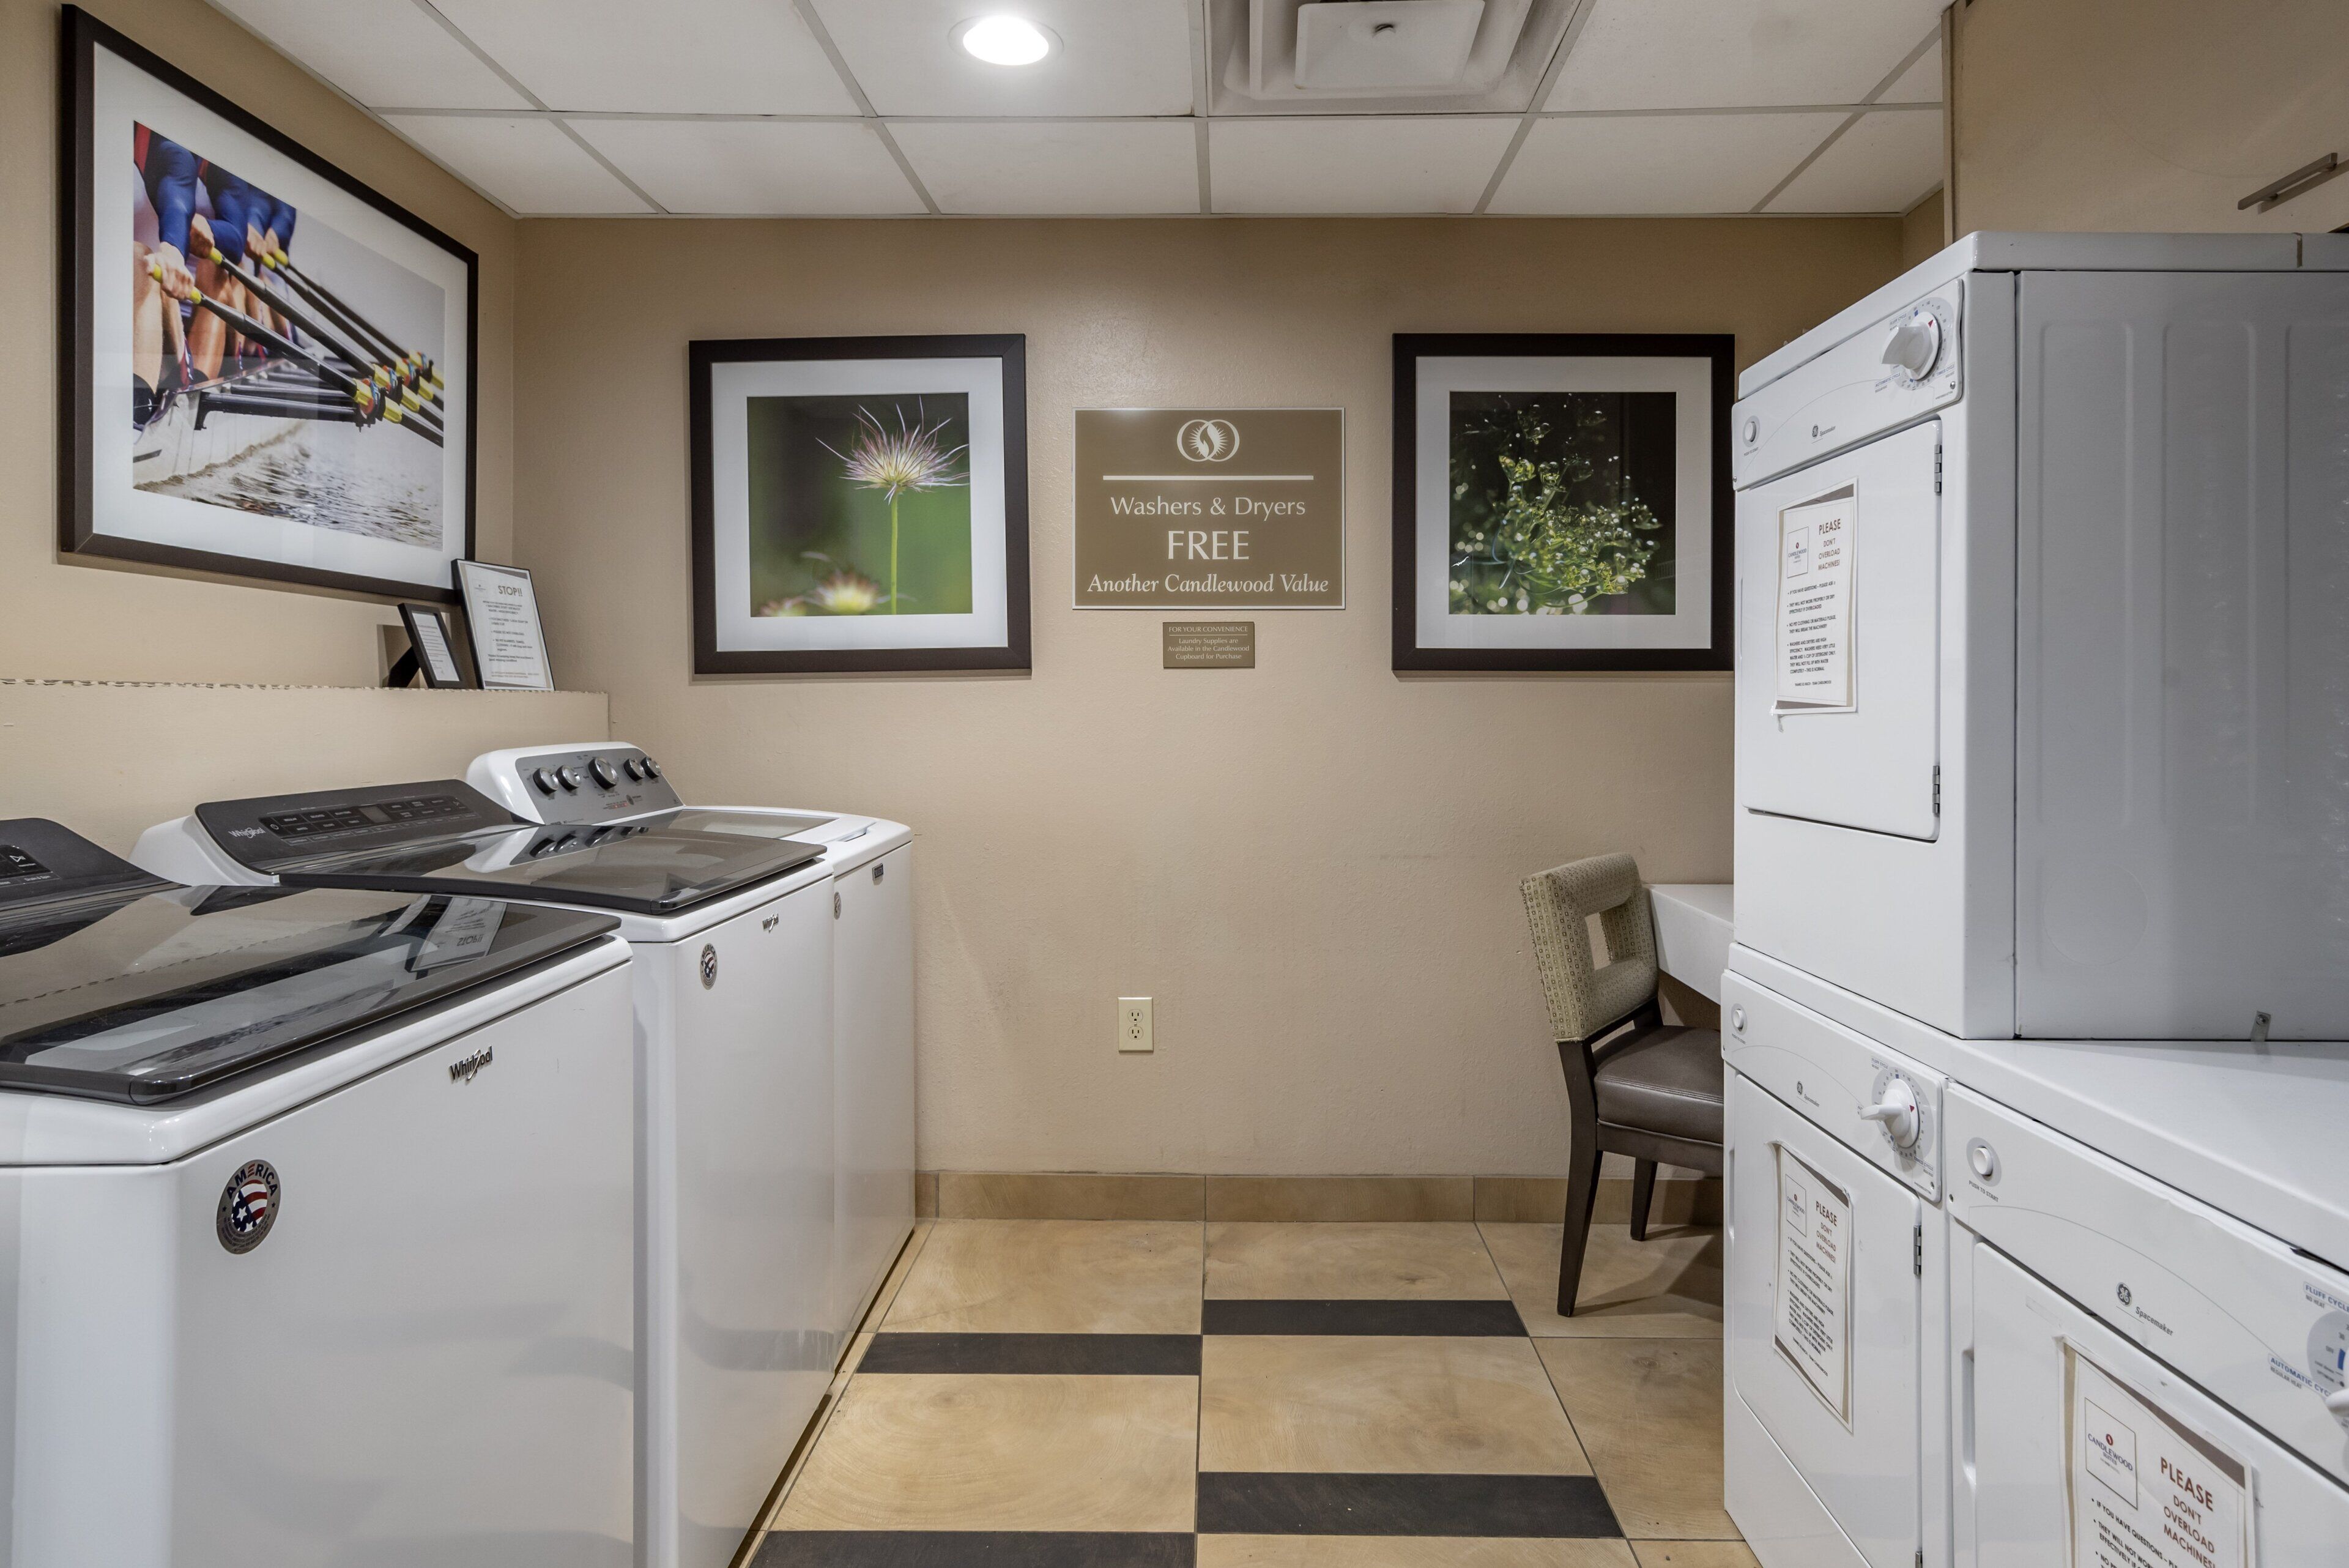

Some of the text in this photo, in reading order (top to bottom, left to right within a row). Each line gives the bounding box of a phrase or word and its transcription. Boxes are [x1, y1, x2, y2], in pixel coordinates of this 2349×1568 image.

[1110, 496, 1305, 521] Washers & Dryers
[1819, 519, 1841, 535] PLEASE
[1168, 530, 1249, 560] FREE
[1819, 548, 1840, 559] OVERLOAD
[1824, 538, 1836, 548] DON'T
[1818, 559, 1840, 570] MACHINES!
[498, 585, 523, 597] STOP!!
[1087, 573, 1329, 592] Another Candlewood Value
[228, 827, 266, 839] Whirlpool
[450, 1046, 492, 1081] Whirlpool
[226, 1164, 278, 1200] AMERICA
[1969, 1180, 1980, 1191] PUSH
[1986, 1191, 1999, 1203] START
[1816, 1200, 1837, 1227] PLEASE
[1816, 1230, 1836, 1252] OVERLOAD
[1820, 1222, 1832, 1236] DON'T
[2305, 1285, 2349, 1313] FLUFF CYCLE
[2313, 1298, 2325, 1309] HEAT
[2136, 1306, 2173, 1336] Spacemaker
[2270, 1366, 2302, 1389] REGULAR HEAT
[2271, 1358, 2312, 1387] AUTOMATIC
[2314, 1384, 2331, 1397] CYC
[2088, 1433, 2133, 1471] CANDLEWOOD
[2161, 1456, 2214, 1512] PLEASE
[2173, 1495, 2202, 1525] DON'T
[2098, 1521, 2110, 1536] THEY
[2112, 1531, 2123, 1548] WILL
[2124, 1544, 2136, 1558] NOT
[2102, 1504, 2114, 1519] YOU
[2115, 1515, 2131, 1533] HAVE
[2132, 1529, 2163, 1559] QUESTIONS
[2164, 1506, 2215, 1553] OVERLOAD
[2099, 1533, 2130, 1564] EFFECTIVELY
[2101, 1554, 2109, 1566] NO
